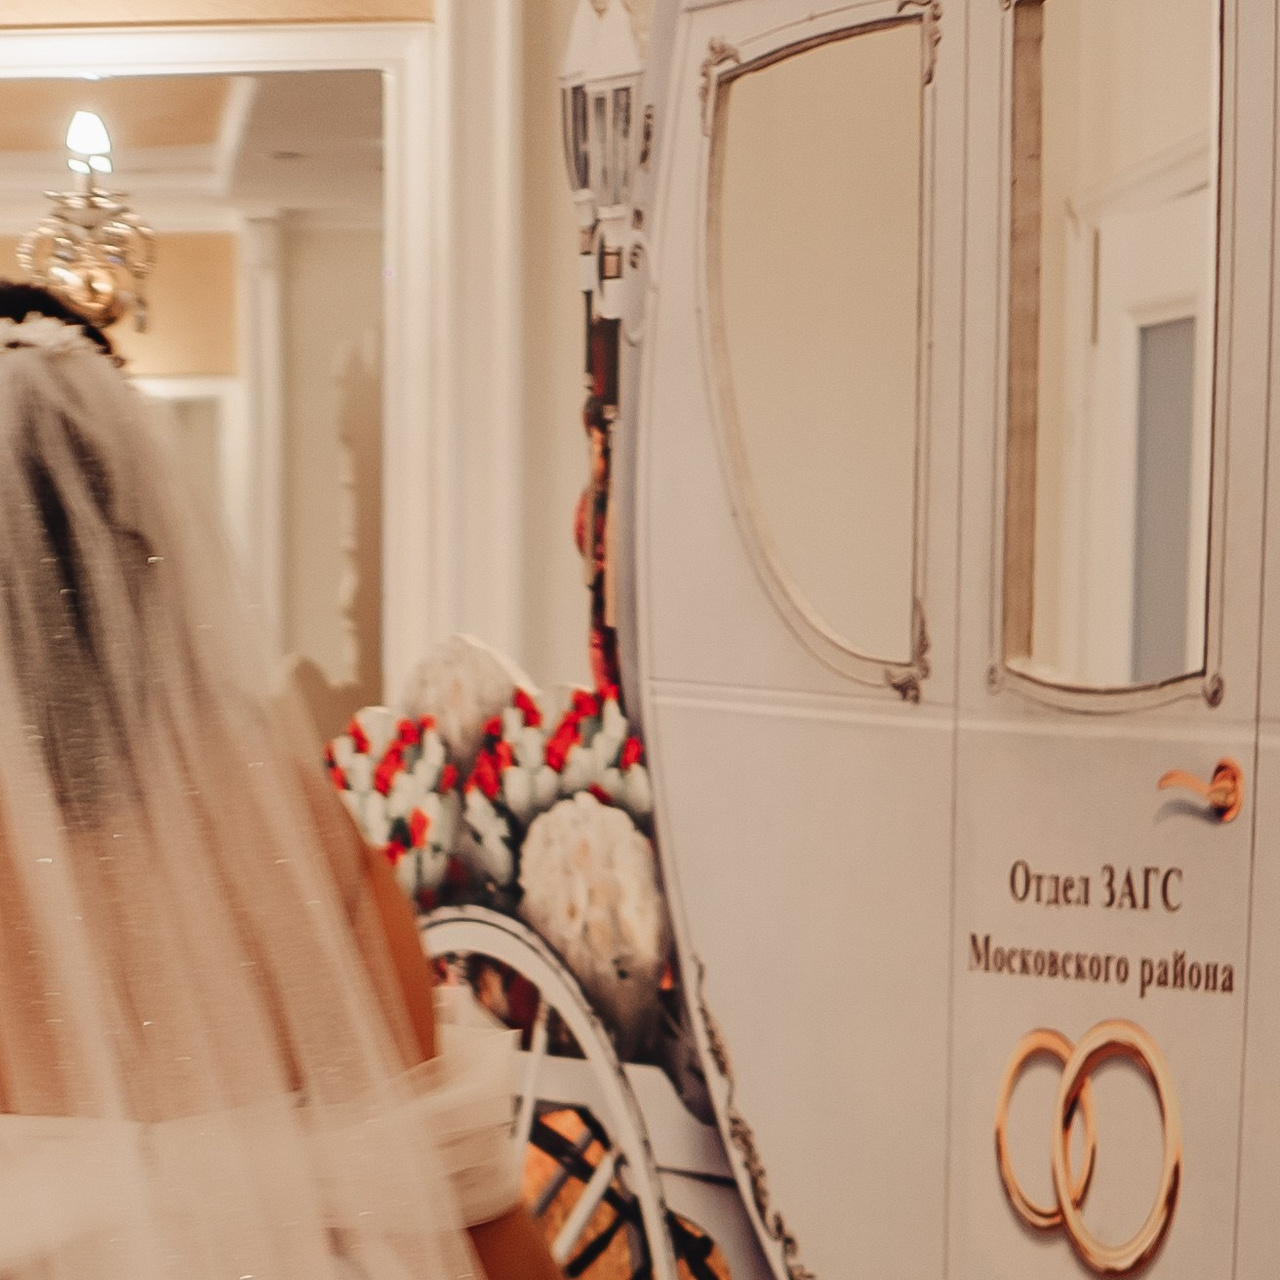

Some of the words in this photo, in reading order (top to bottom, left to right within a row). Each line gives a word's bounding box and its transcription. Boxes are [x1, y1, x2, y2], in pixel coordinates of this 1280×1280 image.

[1009, 859, 1090, 909] Отдел
[1101, 863, 1184, 913] ЗАГС
[969, 932, 1130, 984] Московского
[1139, 949, 1235, 999] района
